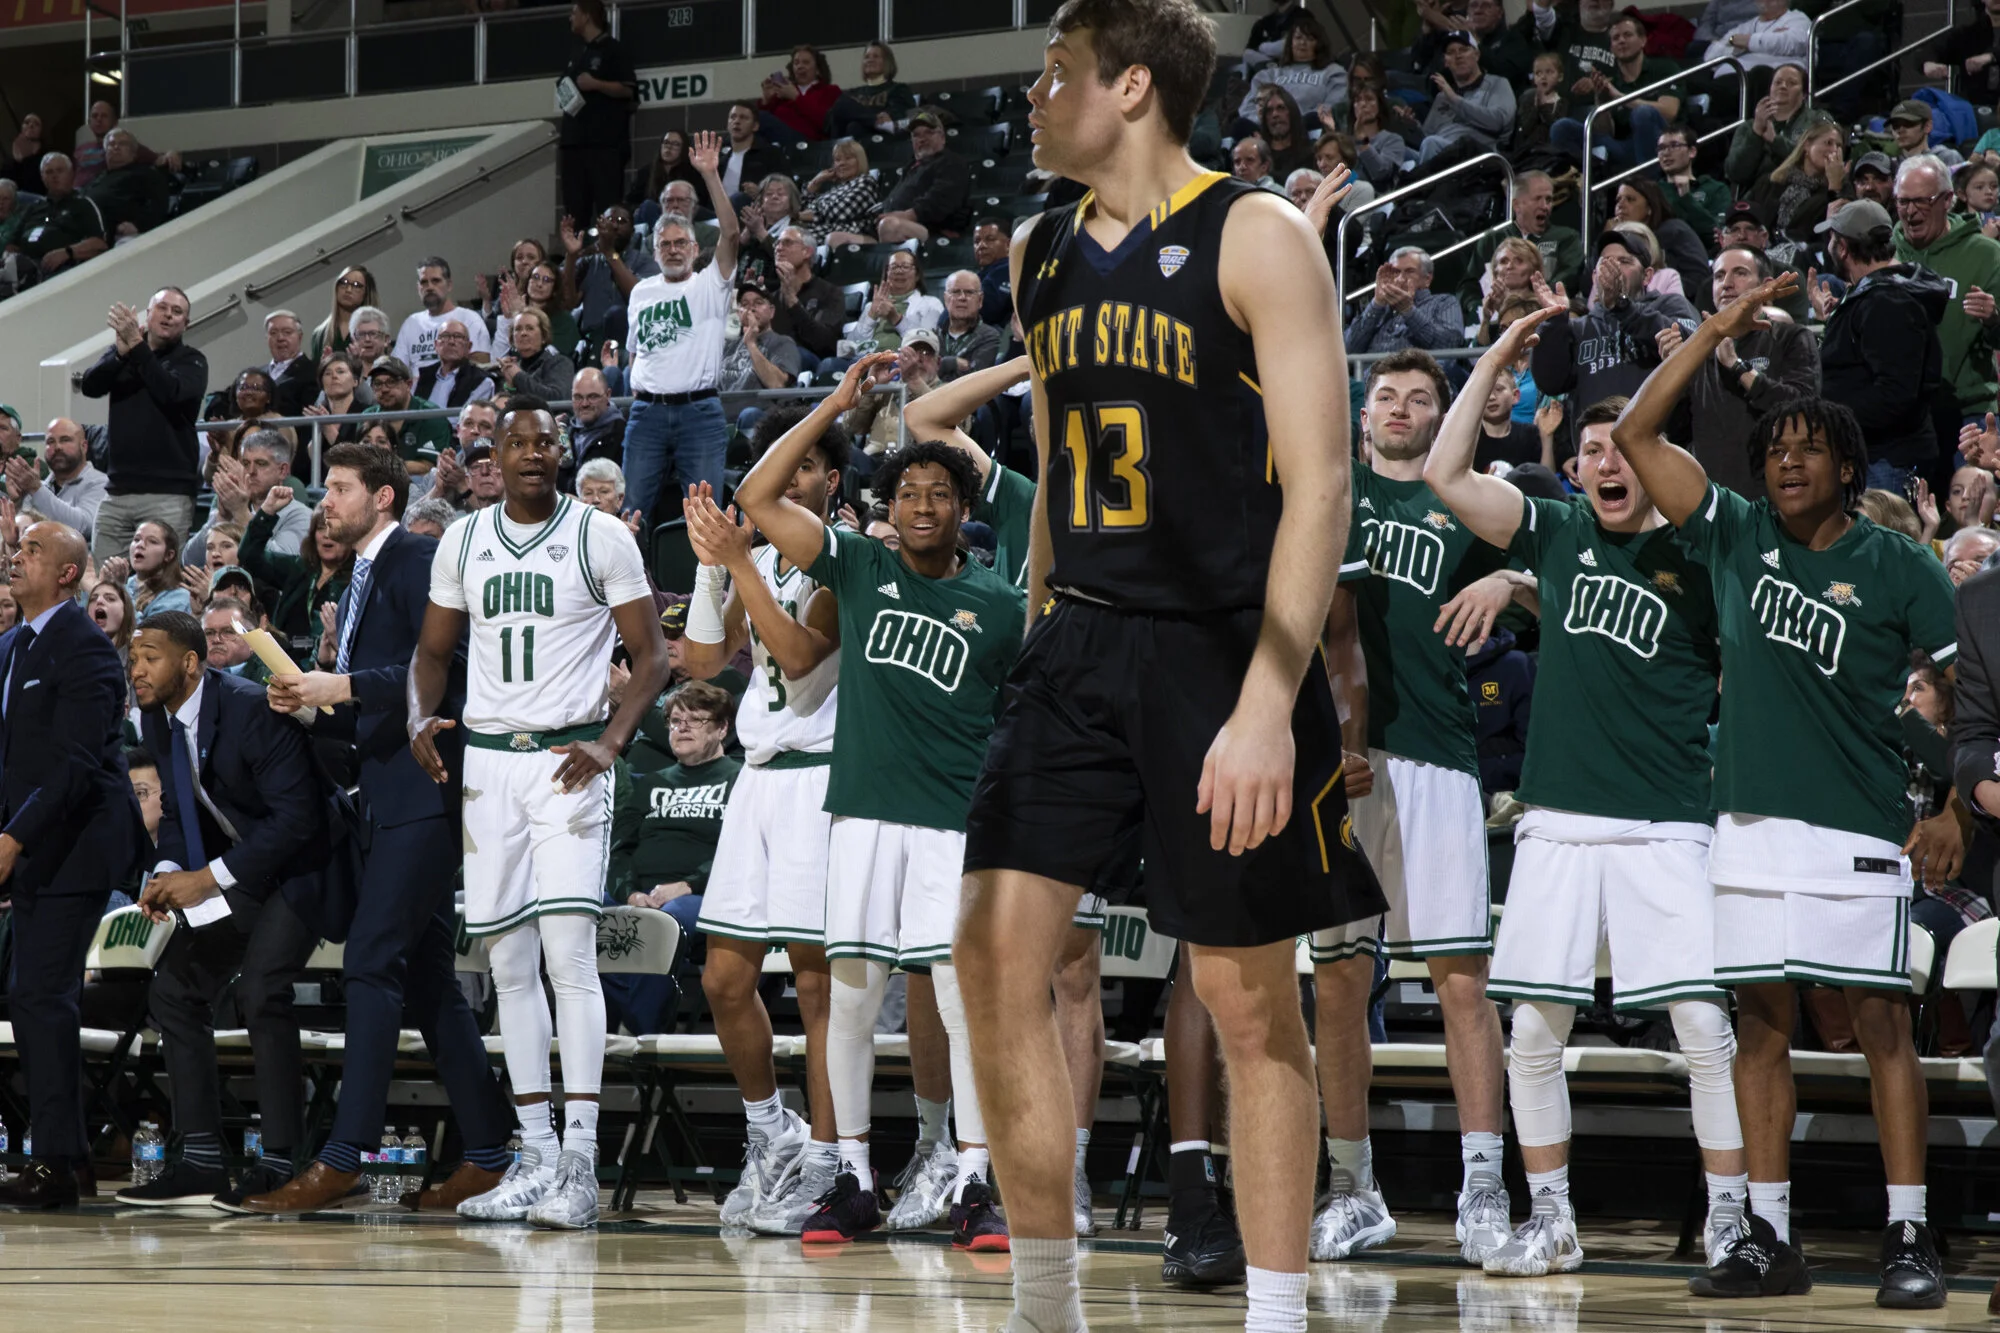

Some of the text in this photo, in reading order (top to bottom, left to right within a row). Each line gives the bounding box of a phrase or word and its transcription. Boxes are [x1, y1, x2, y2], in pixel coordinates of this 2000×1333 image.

[668, 7, 693, 27] 203
[1582, 46, 1616, 67] BOBCATS
[378, 151, 420, 168] OHIO
[412, 342, 435, 354] BOBC
[419, 329, 438, 344] OHI
[1025, 300, 1198, 390] ENT STATE
[1060, 400, 1153, 533] 13
[483, 572, 555, 620] OHIO
[1564, 572, 1668, 659] OHIO
[1751, 574, 1847, 676] OHIO
[499, 625, 536, 683] 11
[865, 609, 970, 693] OHIO
[767, 655, 787, 712] 3
[1484, 685, 1496, 695] M
[650, 781, 728, 809] OHIO
[1101, 914, 1147, 961] HIO
